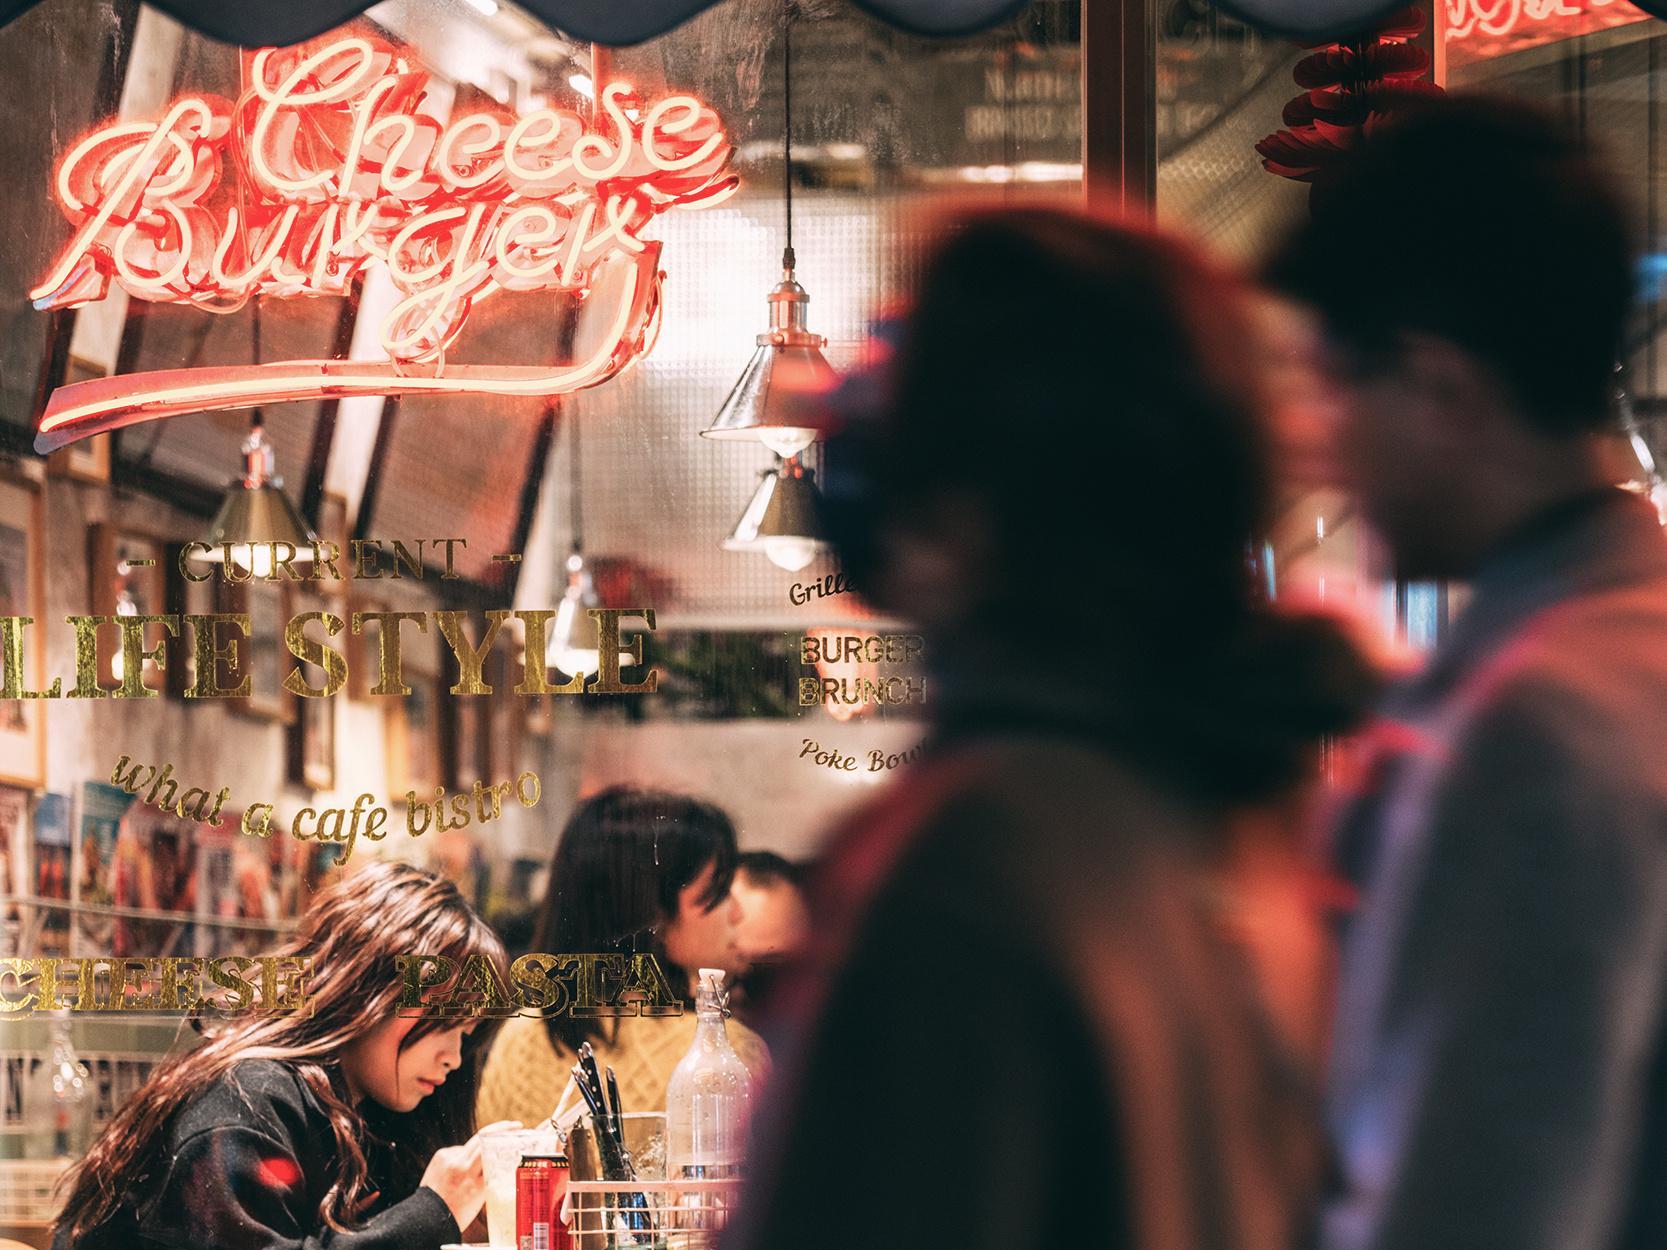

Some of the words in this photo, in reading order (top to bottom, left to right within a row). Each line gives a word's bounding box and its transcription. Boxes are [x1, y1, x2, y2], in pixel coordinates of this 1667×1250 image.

[251, 36, 726, 200] Cheese
[29, 98, 650, 352] Burger
[178, 539, 467, 582] CURRENT
[0, 614, 253, 699] LIFE
[282, 610, 658, 698] STYLE
[800, 636, 926, 665] BURGER
[799, 676, 927, 706] BRUNCH
[799, 738, 857, 771] Poke
[110, 754, 231, 828] what
[240, 800, 274, 840] a
[291, 793, 389, 867] cafe
[406, 771, 542, 838] bistro
[0, 956, 315, 1020] CHEESE
[395, 952, 684, 1019] PASTA
